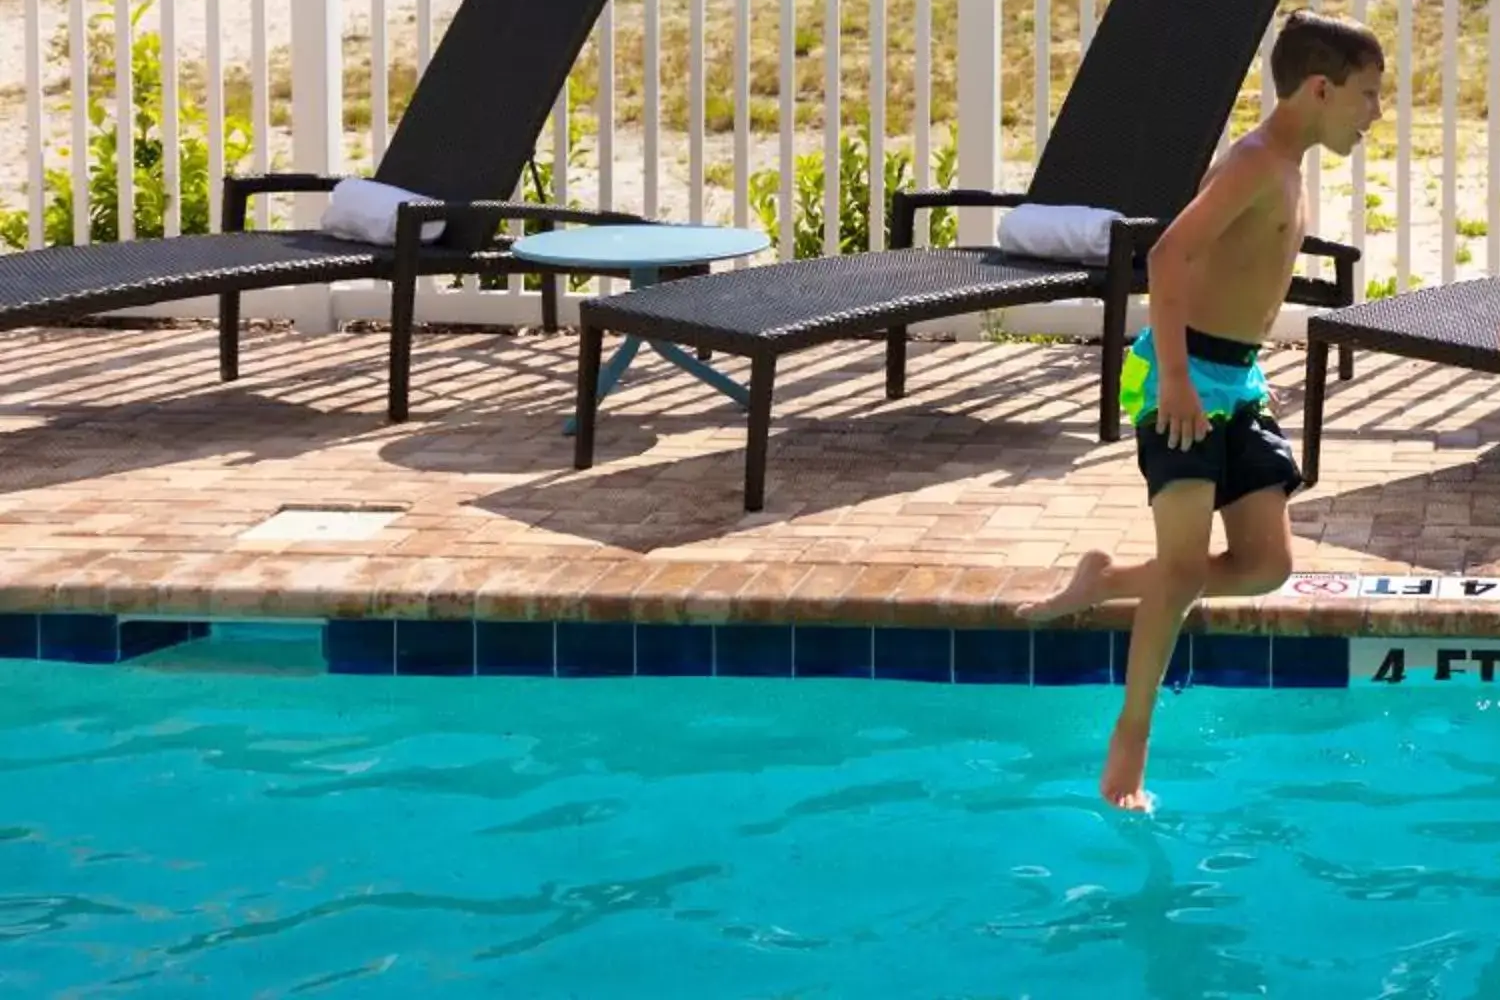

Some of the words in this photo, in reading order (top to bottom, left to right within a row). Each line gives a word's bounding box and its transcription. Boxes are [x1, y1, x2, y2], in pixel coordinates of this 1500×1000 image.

[1366, 578, 1432, 594] FT
[1461, 580, 1497, 595] 4
[1371, 648, 1406, 682] 4
